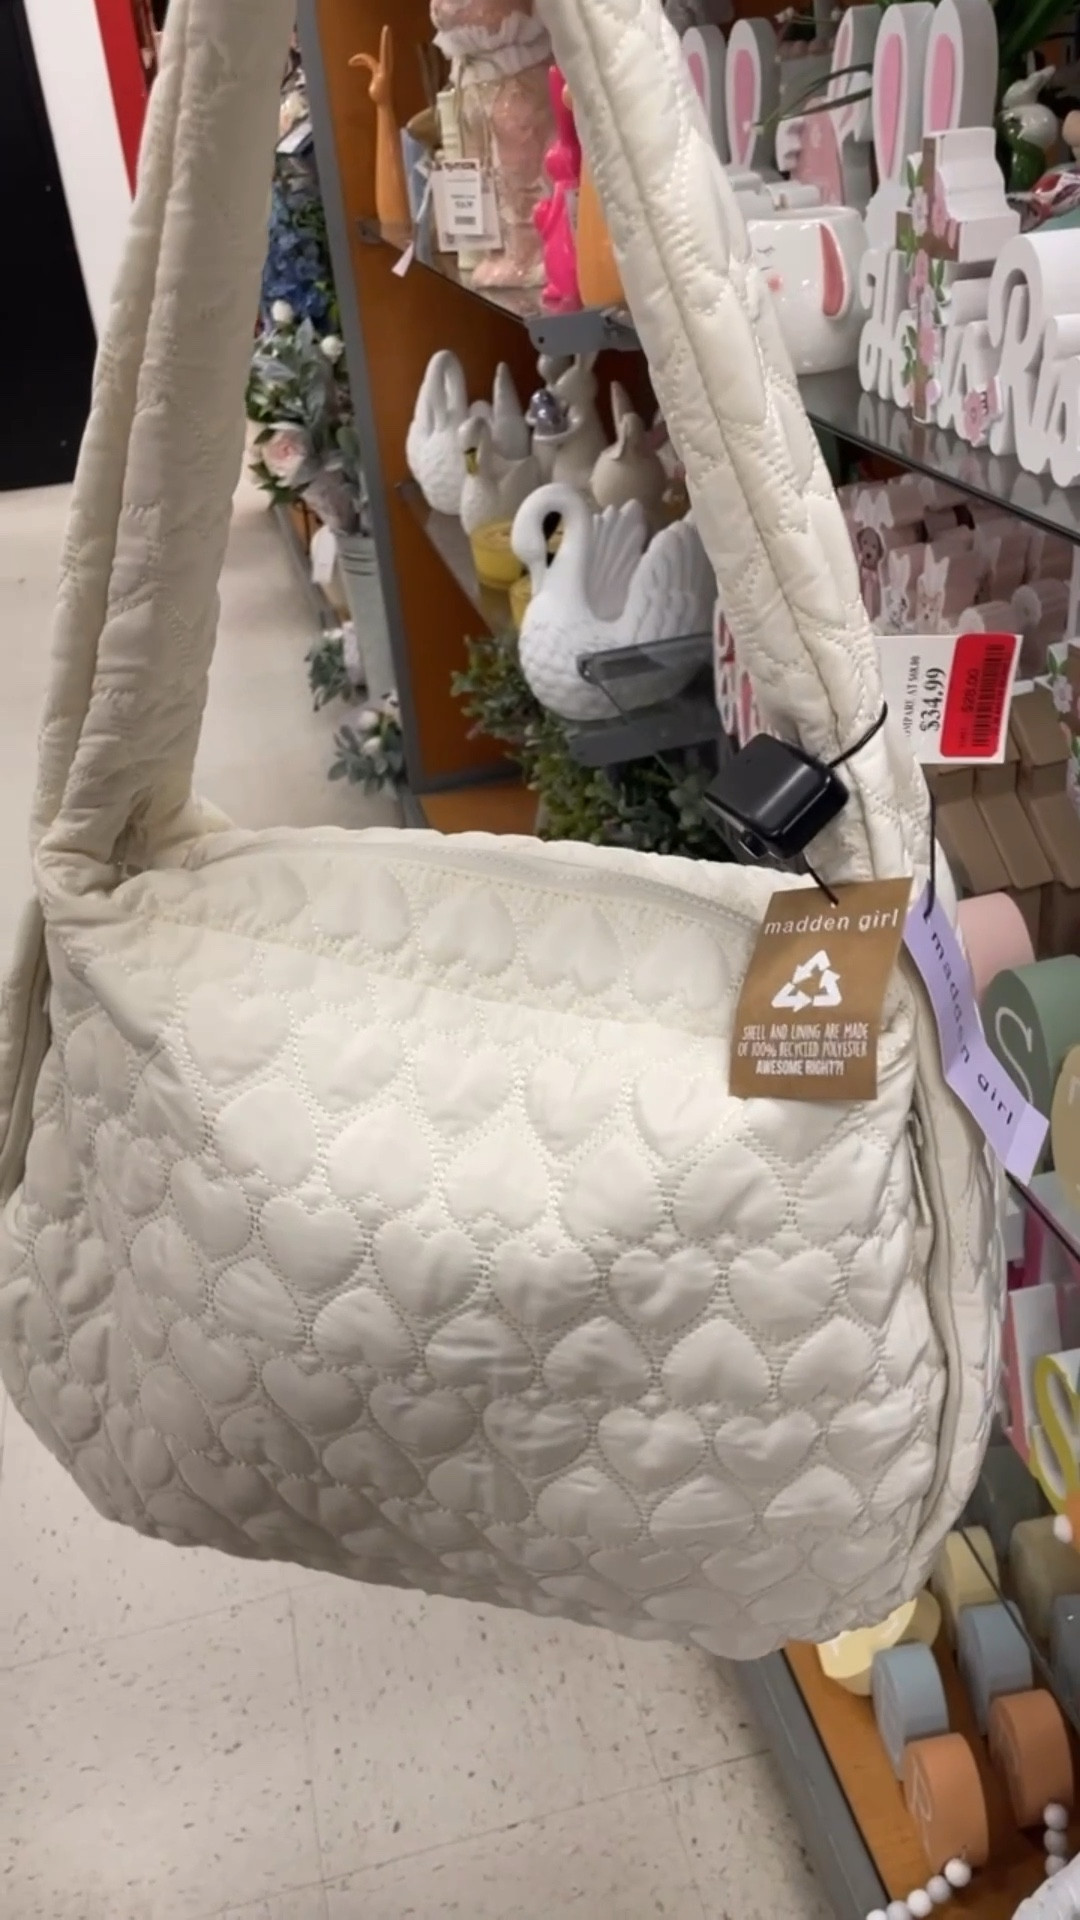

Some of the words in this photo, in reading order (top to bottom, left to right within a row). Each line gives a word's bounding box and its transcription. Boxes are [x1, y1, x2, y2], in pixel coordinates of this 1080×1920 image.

[906, 683, 918, 695] AT
[919, 667, 946, 732] $34.99
[764, 915, 850, 935] madden
[858, 909, 899, 932] girl
[742, 1024, 766, 1041] SHELL
[769, 1023, 788, 1040] AND
[790, 1023, 821, 1040] LINING
[824, 1023, 840, 1040] ARE
[843, 1022, 869, 1040] MADE
[930, 932, 971, 1065] madden
[976, 1072, 1014, 1126] girl
[737, 1042, 749, 1057] OF
[751, 1042, 777, 1057] 100%
[779, 1041, 820, 1058] RECYCLED
[822, 1041, 868, 1058] POLYESTER
[755, 1060, 803, 1075] AWESOME
